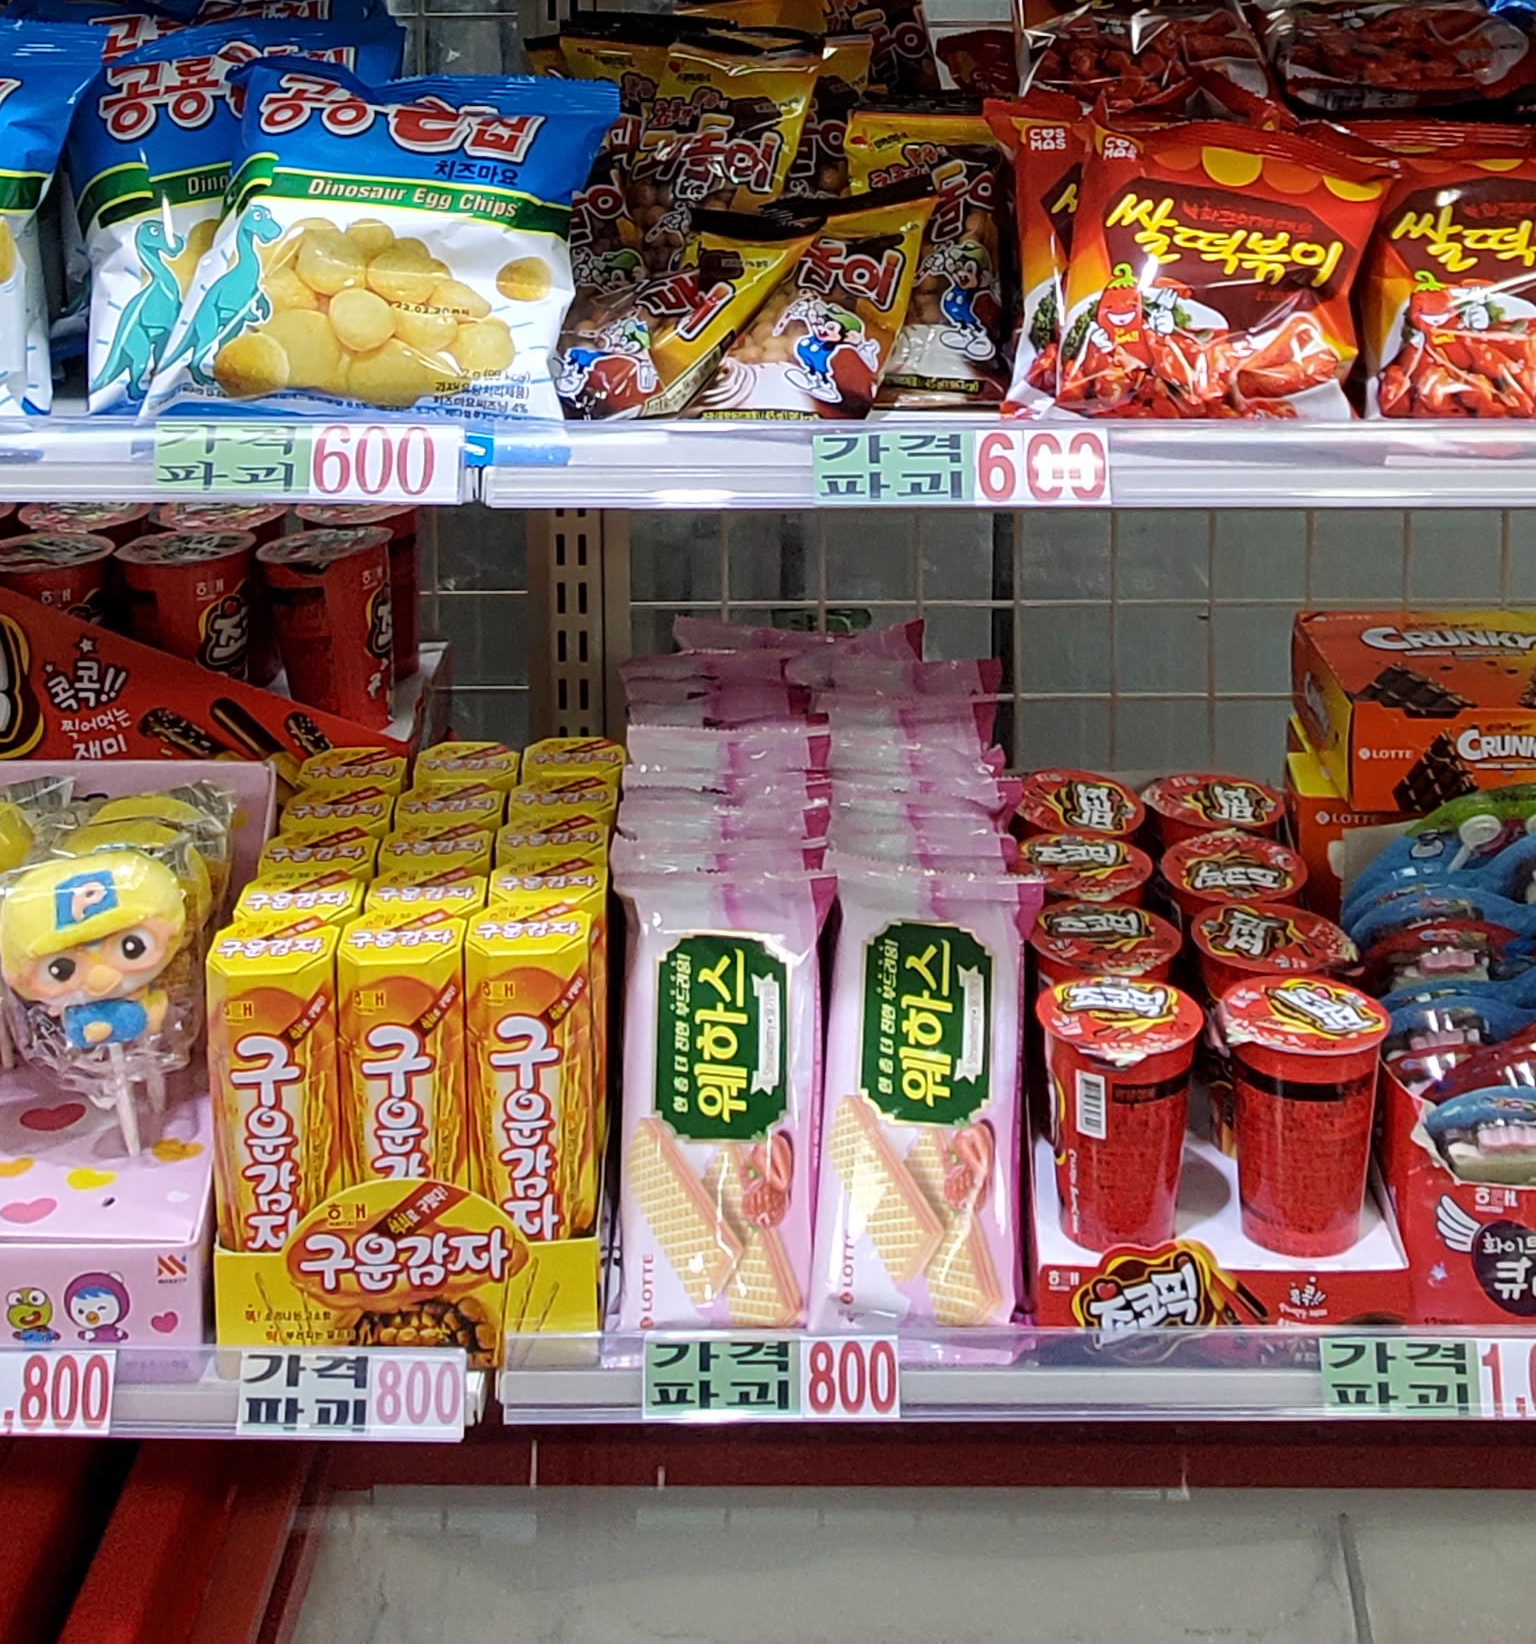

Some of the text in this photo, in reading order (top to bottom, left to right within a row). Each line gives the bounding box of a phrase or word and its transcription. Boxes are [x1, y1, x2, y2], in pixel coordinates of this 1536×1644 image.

[307, 178, 520, 219] Dinosaur Egg Chips
[434, 159, 519, 186] 치즈마요
[1105, 192, 1344, 288] 쌀떡볶이
[313, 424, 435, 497] 600
[46, 659, 129, 710] 콕콕!!
[60, 707, 132, 739] 찍어먹는
[73, 732, 128, 761] 재미
[1371, 748, 1413, 760] LOTTE
[217, 935, 324, 957] 구운감자
[474, 918, 582, 940] 구운감자
[694, 948, 749, 1123] 웨하스
[898, 939, 953, 1107] 웨하스
[300, 1228, 508, 1292] 구운감자
[641, 1253, 655, 1313] LOTTE
[377, 1359, 458, 1425] 800
[807, 1339, 897, 1415] 800
